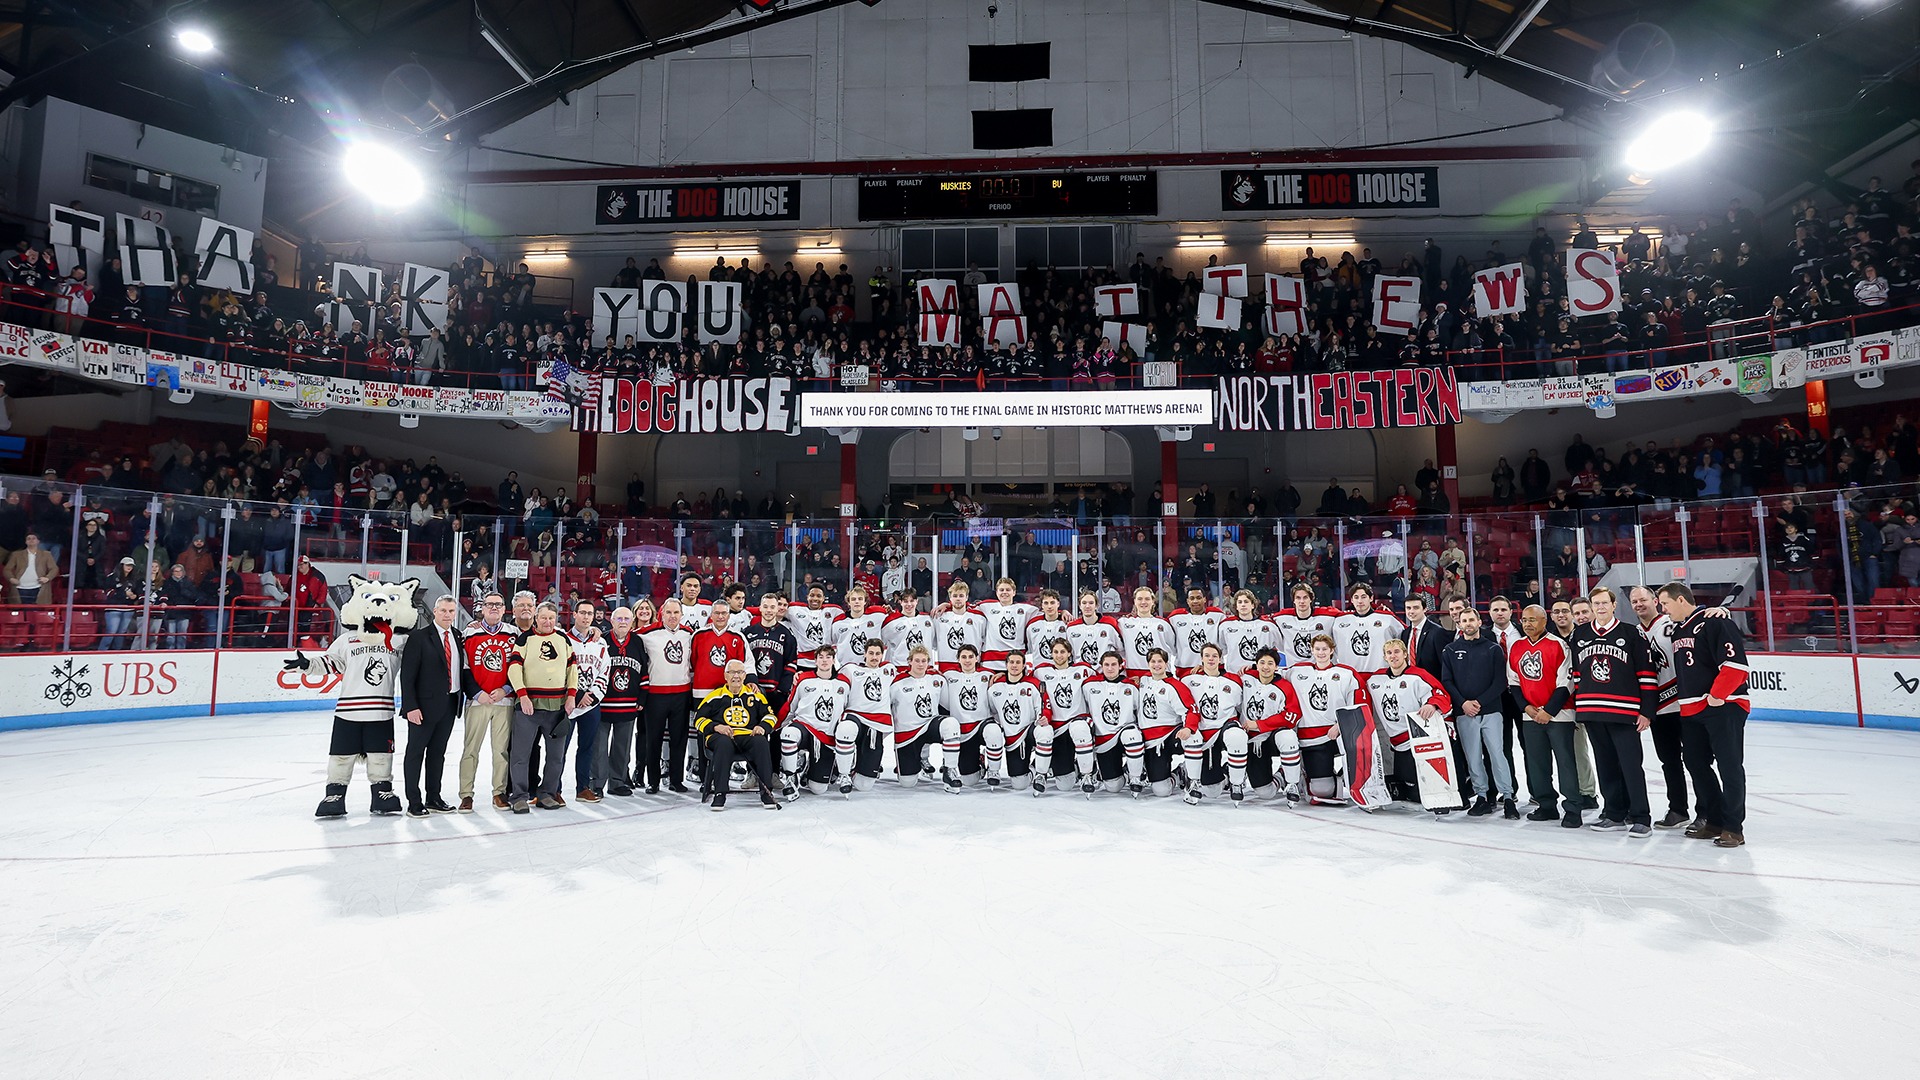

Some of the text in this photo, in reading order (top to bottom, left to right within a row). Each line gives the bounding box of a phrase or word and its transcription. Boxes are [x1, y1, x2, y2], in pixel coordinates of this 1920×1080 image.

[940, 182, 971, 191] HUSKIES
[1052, 180, 1062, 188] BU
[1264, 172, 1426, 204] THE DOG HOUSE
[637, 186, 788, 218] THE DOG HOUSE
[82, 340, 108, 354] VIN
[118, 345, 139, 356] GET
[47, 345, 76, 362] PERFECT
[112, 362, 136, 374] WITH
[1806, 355, 1851, 370] FREDERICKS
[82, 362, 108, 375] WIN
[207, 365, 214, 374] 9
[221, 362, 255, 381] ELITE
[135, 373, 146, 383] IT
[364, 382, 398, 393] ROLLIN
[402, 387, 433, 398] MOORE
[339, 396, 350, 404] 33
[365, 390, 396, 399] NOLAN
[472, 391, 505, 401] HENRY
[1220, 366, 1462, 431] NORTHEASTERN
[299, 400, 326, 408] JAMES
[615, 379, 677, 433] DOG
[678, 378, 791, 433] HOUSE
[810, 403, 1203, 416] THANK YOU FOR COMING TO THE FINAL GAME IN HISTORIC MATTHEWS ARENA!
[1446, 467, 1454, 476] 17
[843, 505, 852, 514] 15
[1166, 505, 1175, 513] 16
[779, 634, 785, 642] C
[350, 645, 399, 657] NORTHEASTRN
[1577, 643, 1629, 664] NORTHEASTERN
[1724, 642, 1736, 658] 3
[1685, 651, 1695, 666] 3
[1083, 669, 1089, 678] A
[102, 661, 178, 698] UBS
[1748, 670, 1788, 691] OUSE.
[1026, 688, 1032, 696] C
[747, 696, 755, 707] C
